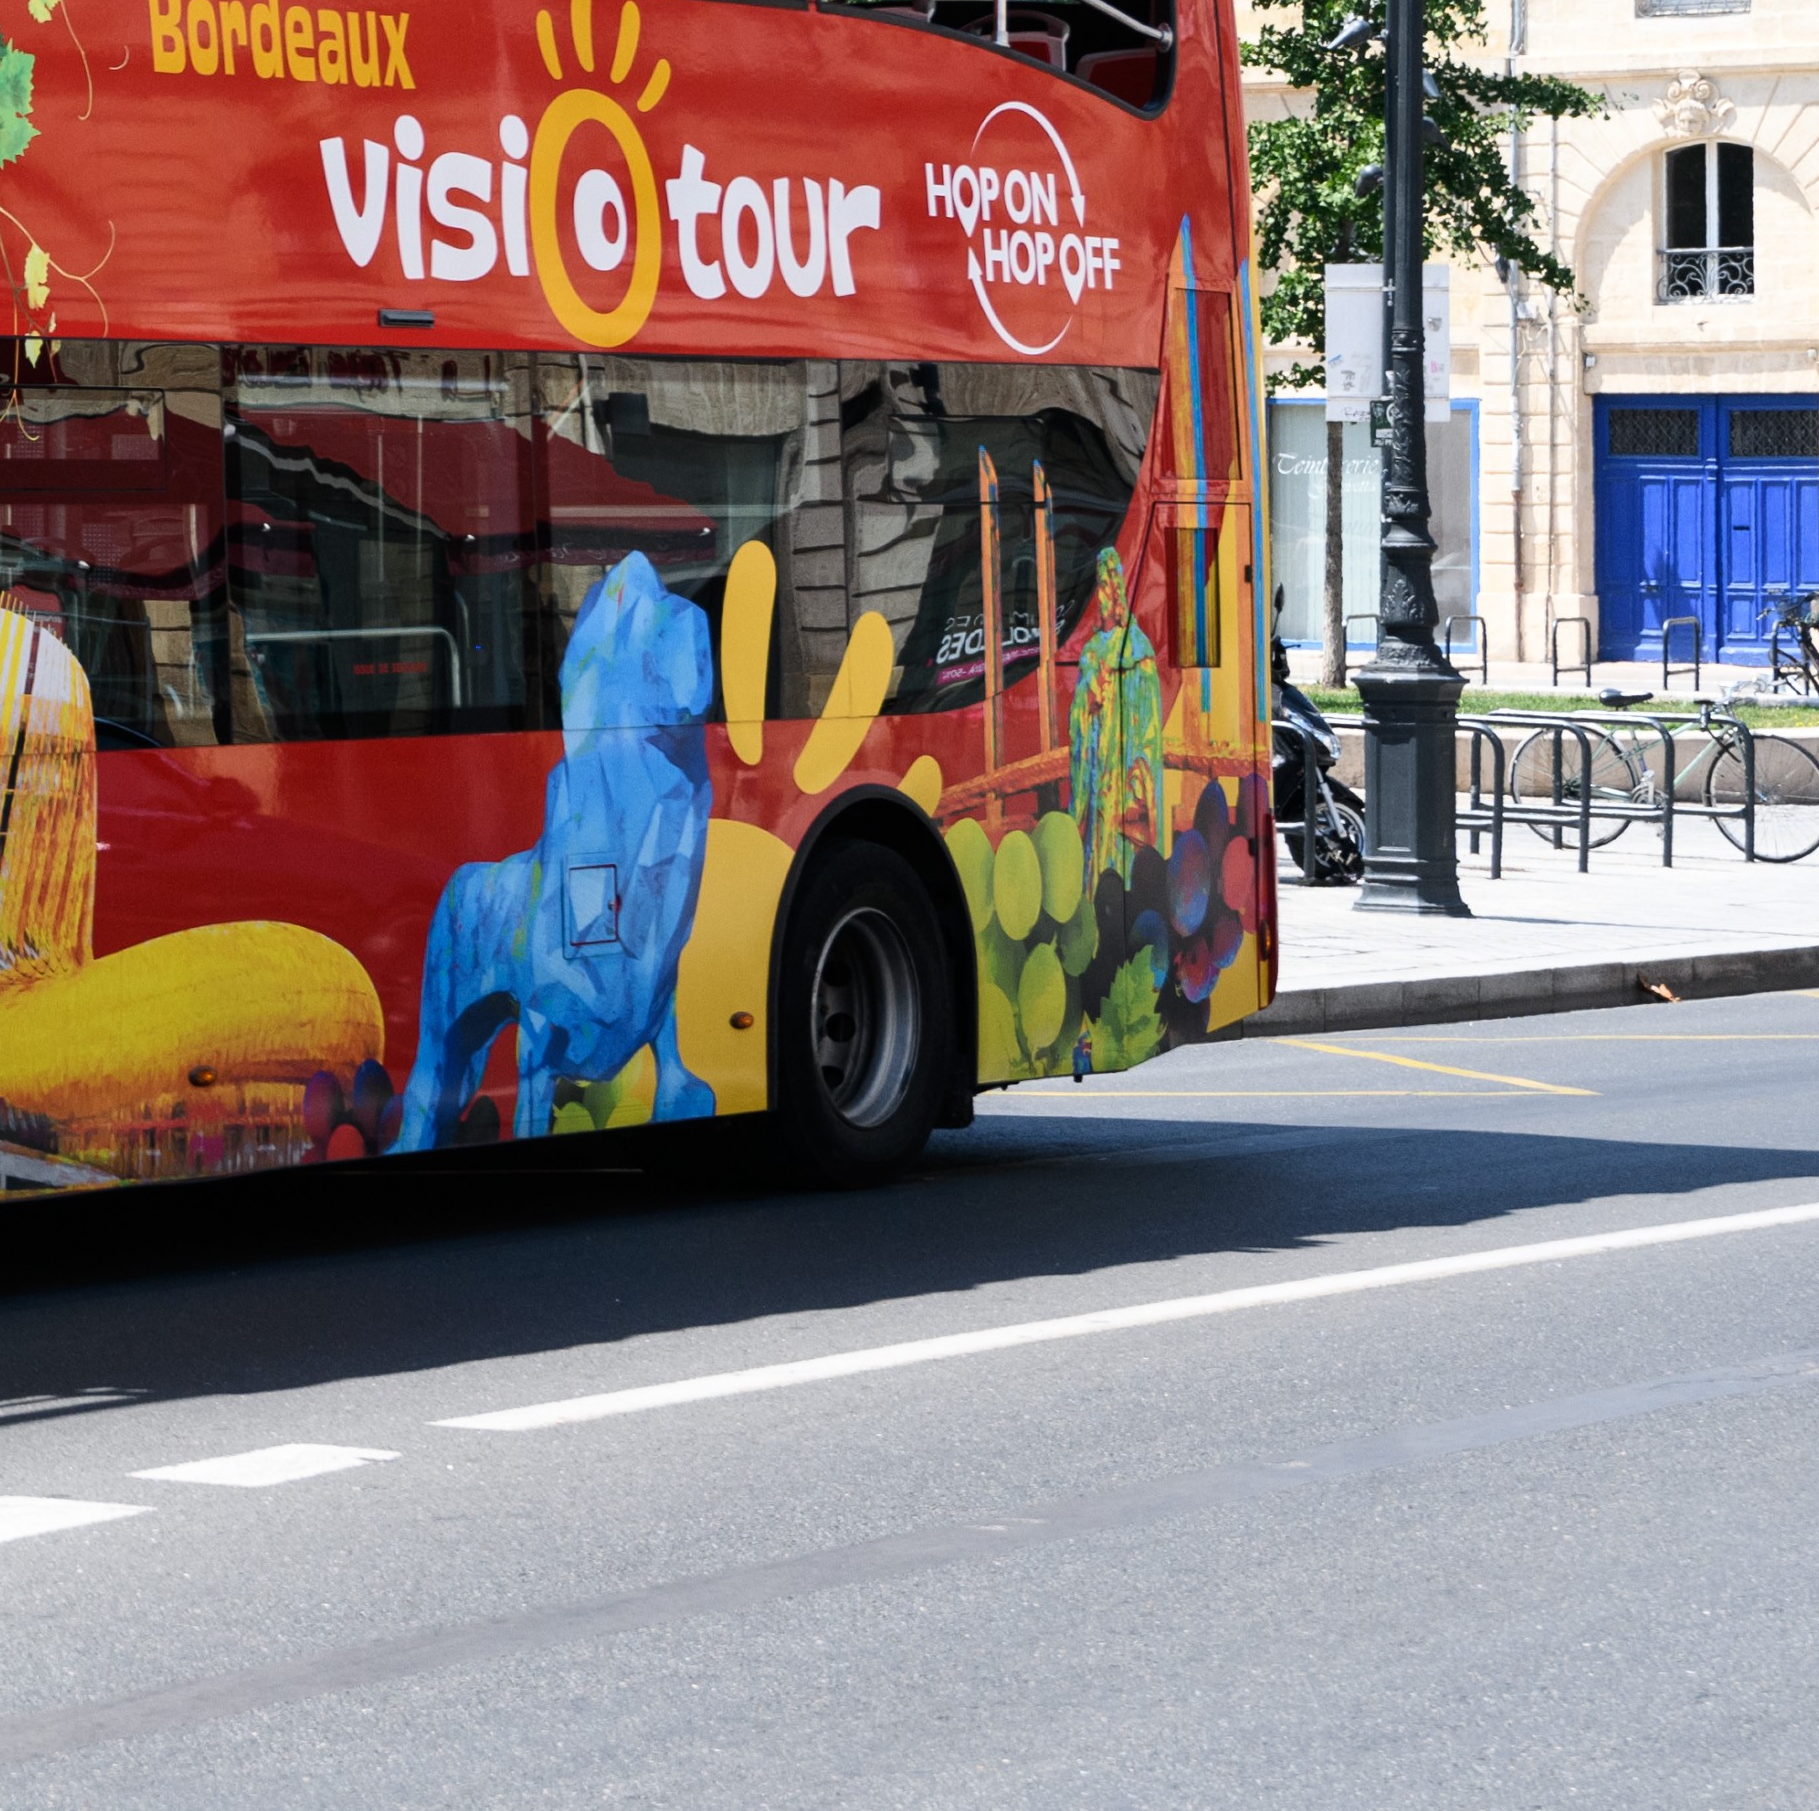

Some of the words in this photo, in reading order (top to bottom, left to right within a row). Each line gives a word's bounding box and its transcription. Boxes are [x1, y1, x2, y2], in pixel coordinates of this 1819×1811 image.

[925, 163, 1000, 238] HOP
[1004, 169, 1058, 226] ON
[983, 228, 1055, 285] HOP
[1059, 233, 1121, 305] OFF
